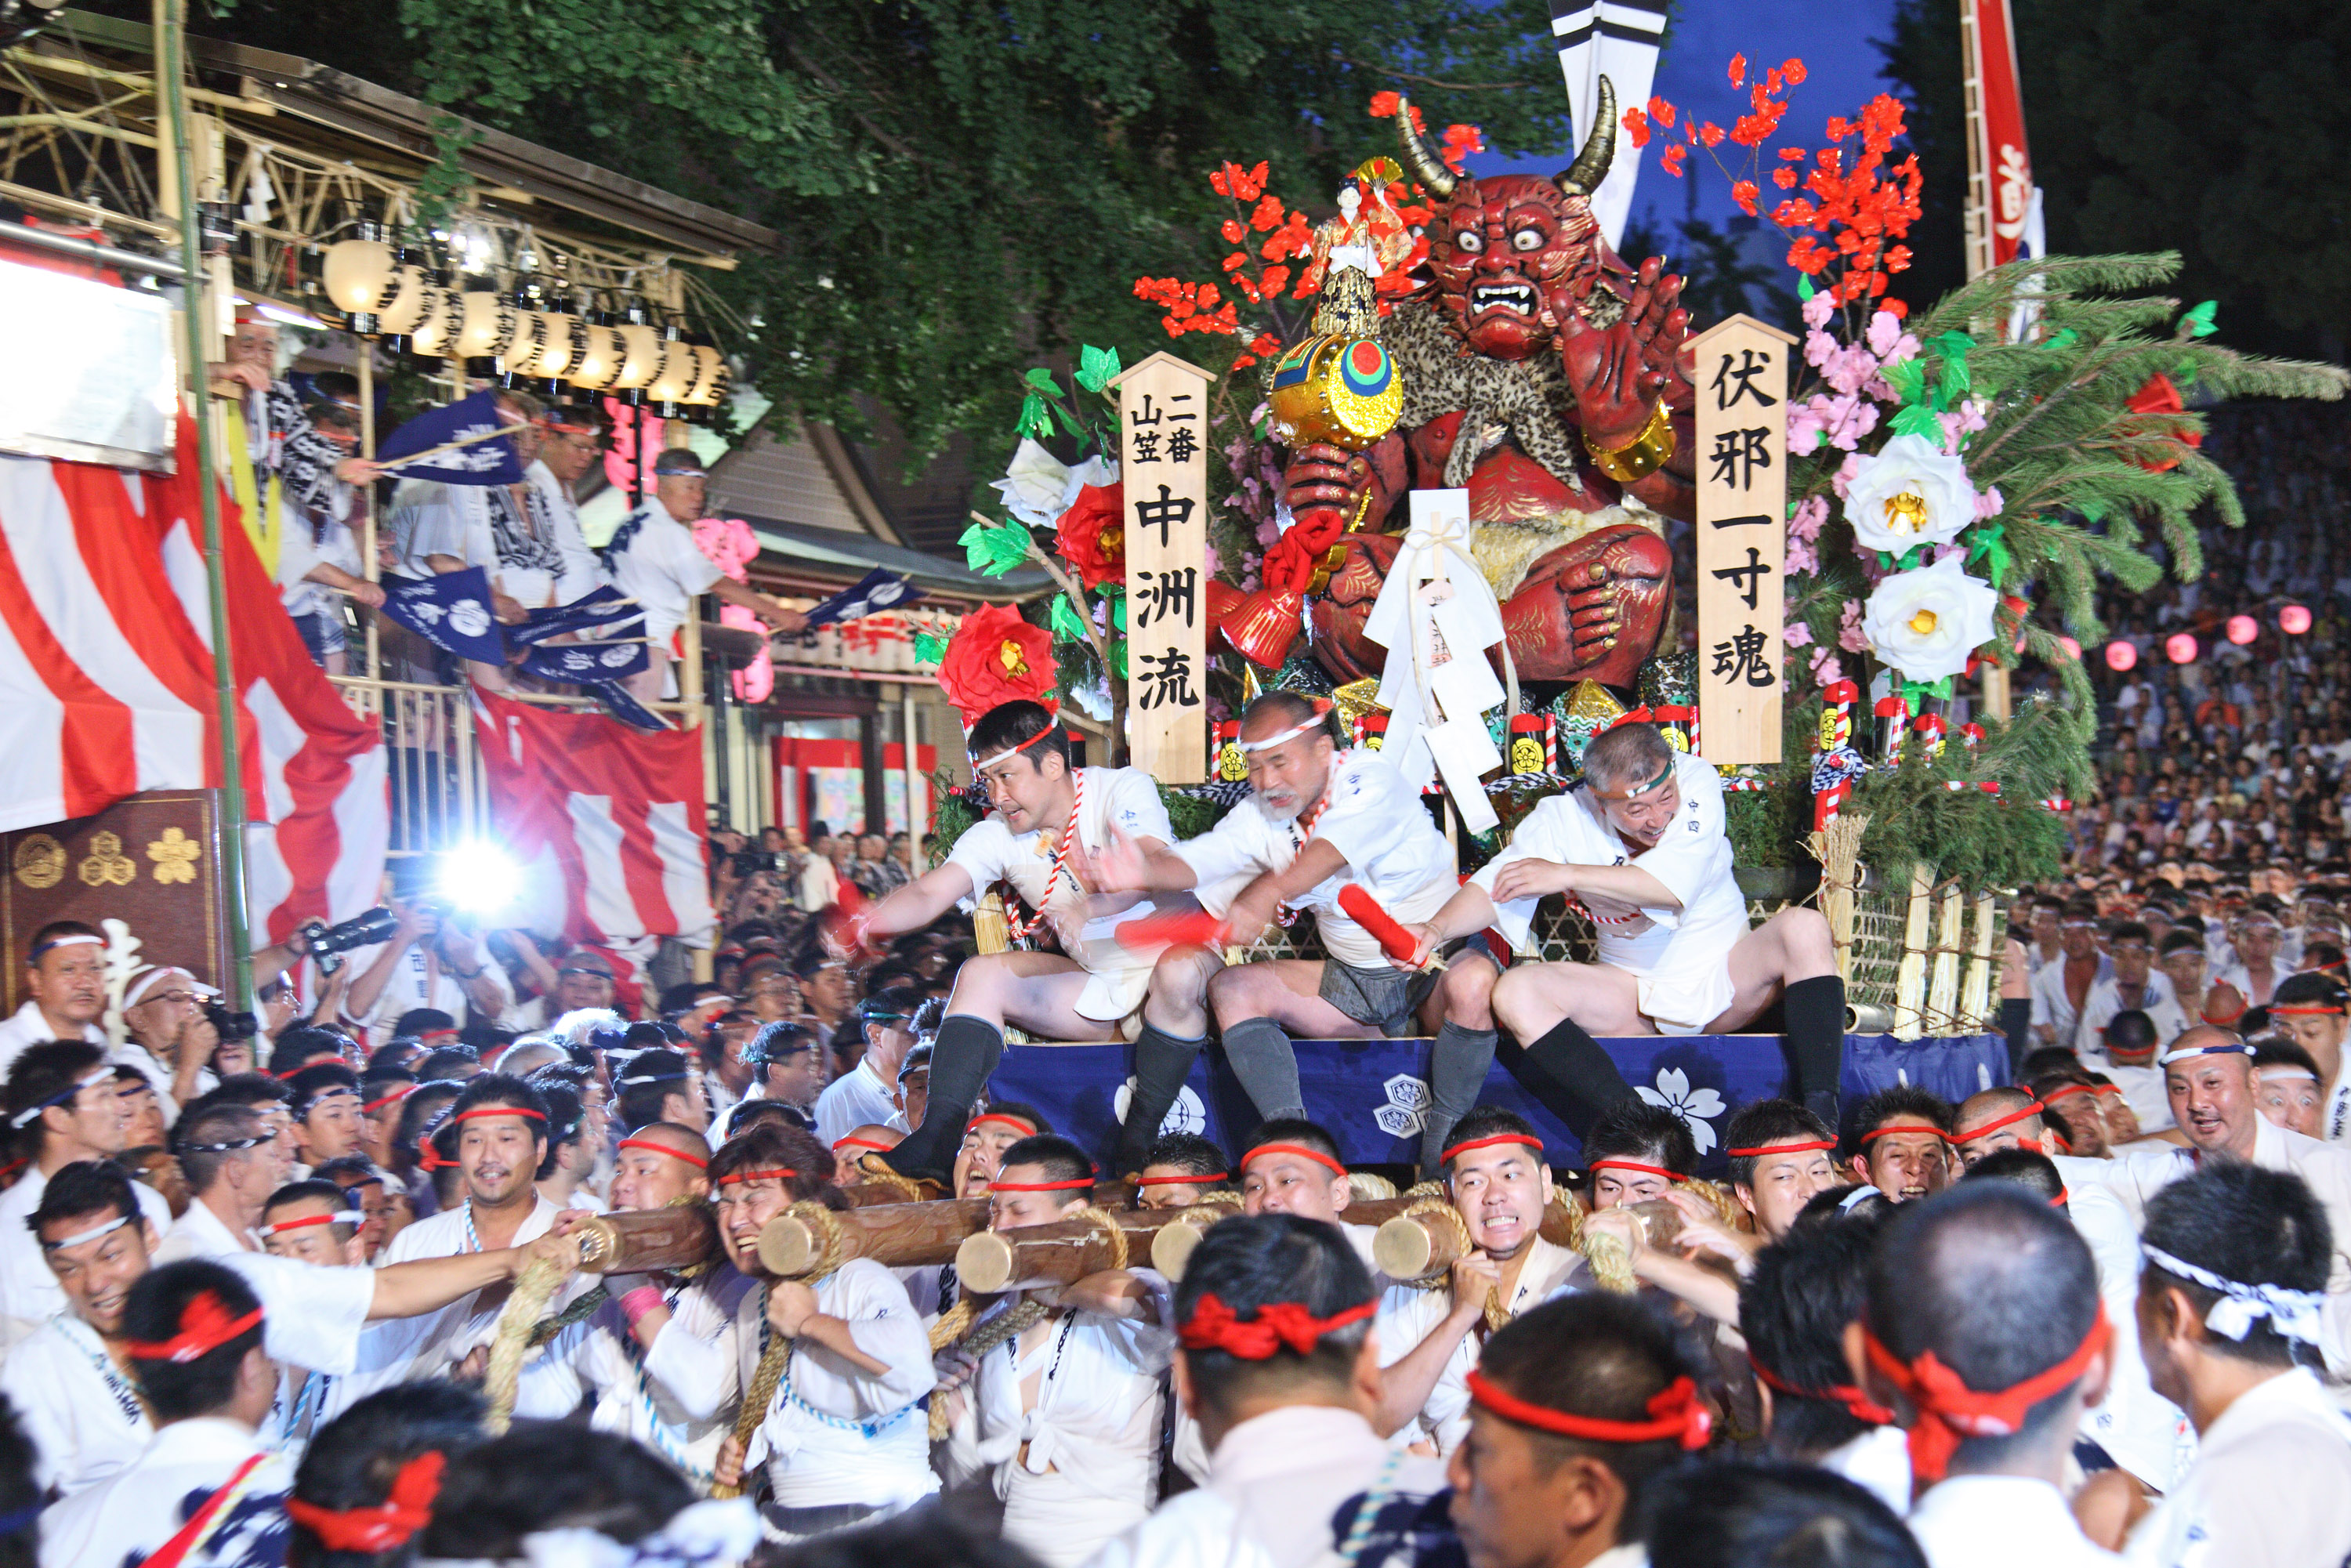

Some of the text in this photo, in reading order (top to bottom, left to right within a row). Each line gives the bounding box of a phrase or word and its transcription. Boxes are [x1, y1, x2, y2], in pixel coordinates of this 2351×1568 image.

[1131, 394, 1162, 464] 山笠
[1165, 394, 1200, 464] 二番
[1709, 349, 1777, 688] 伏邪一寸魂
[1134, 483, 1201, 711] 中洲流
